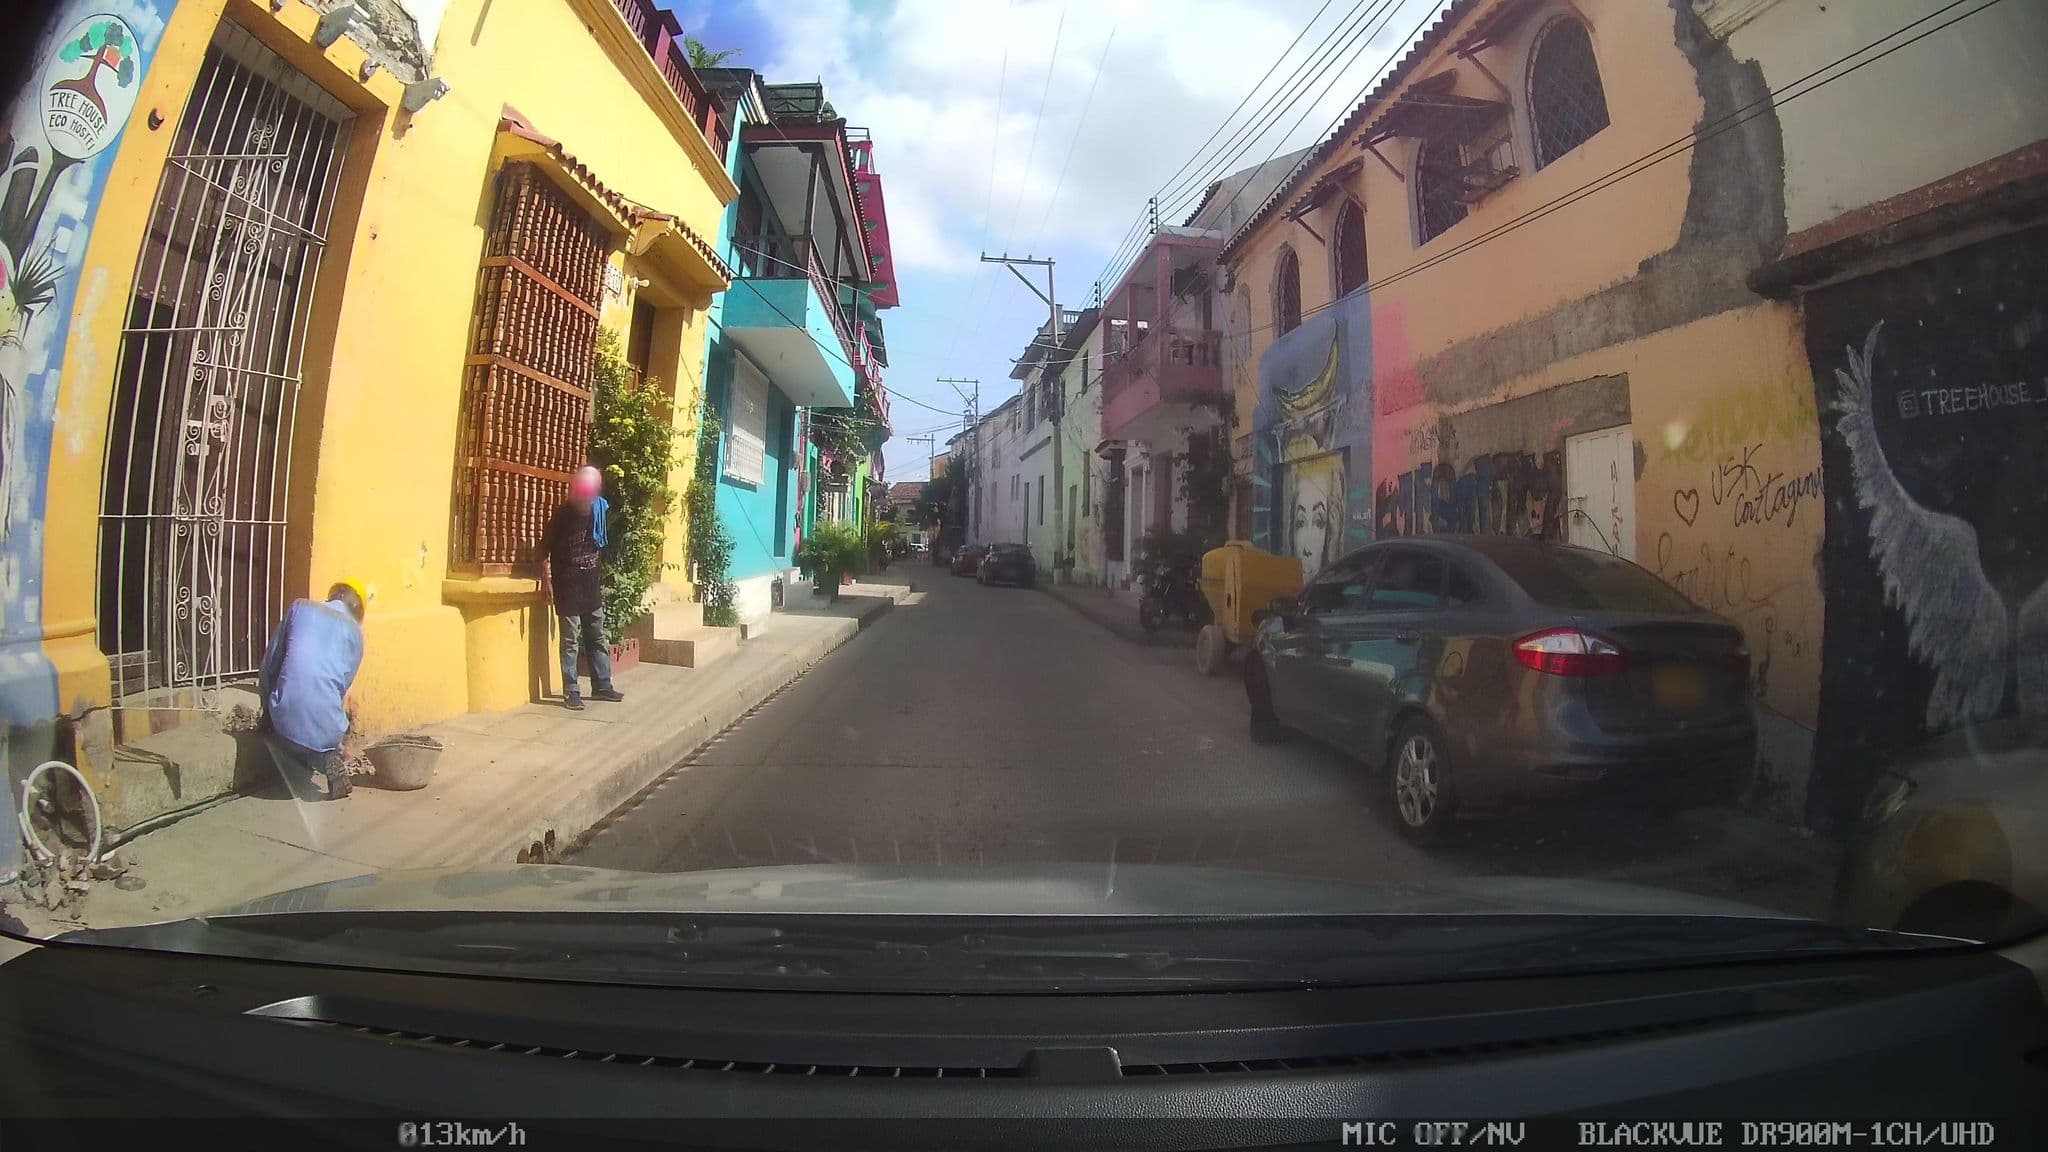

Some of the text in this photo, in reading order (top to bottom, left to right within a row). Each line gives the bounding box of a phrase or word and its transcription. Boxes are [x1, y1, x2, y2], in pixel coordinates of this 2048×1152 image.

[50, 91, 106, 135] TREE HOUSE
[49, 114, 96, 151] ECO HOSTEL
[1920, 381, 2048, 416] TREEHOUSE_
